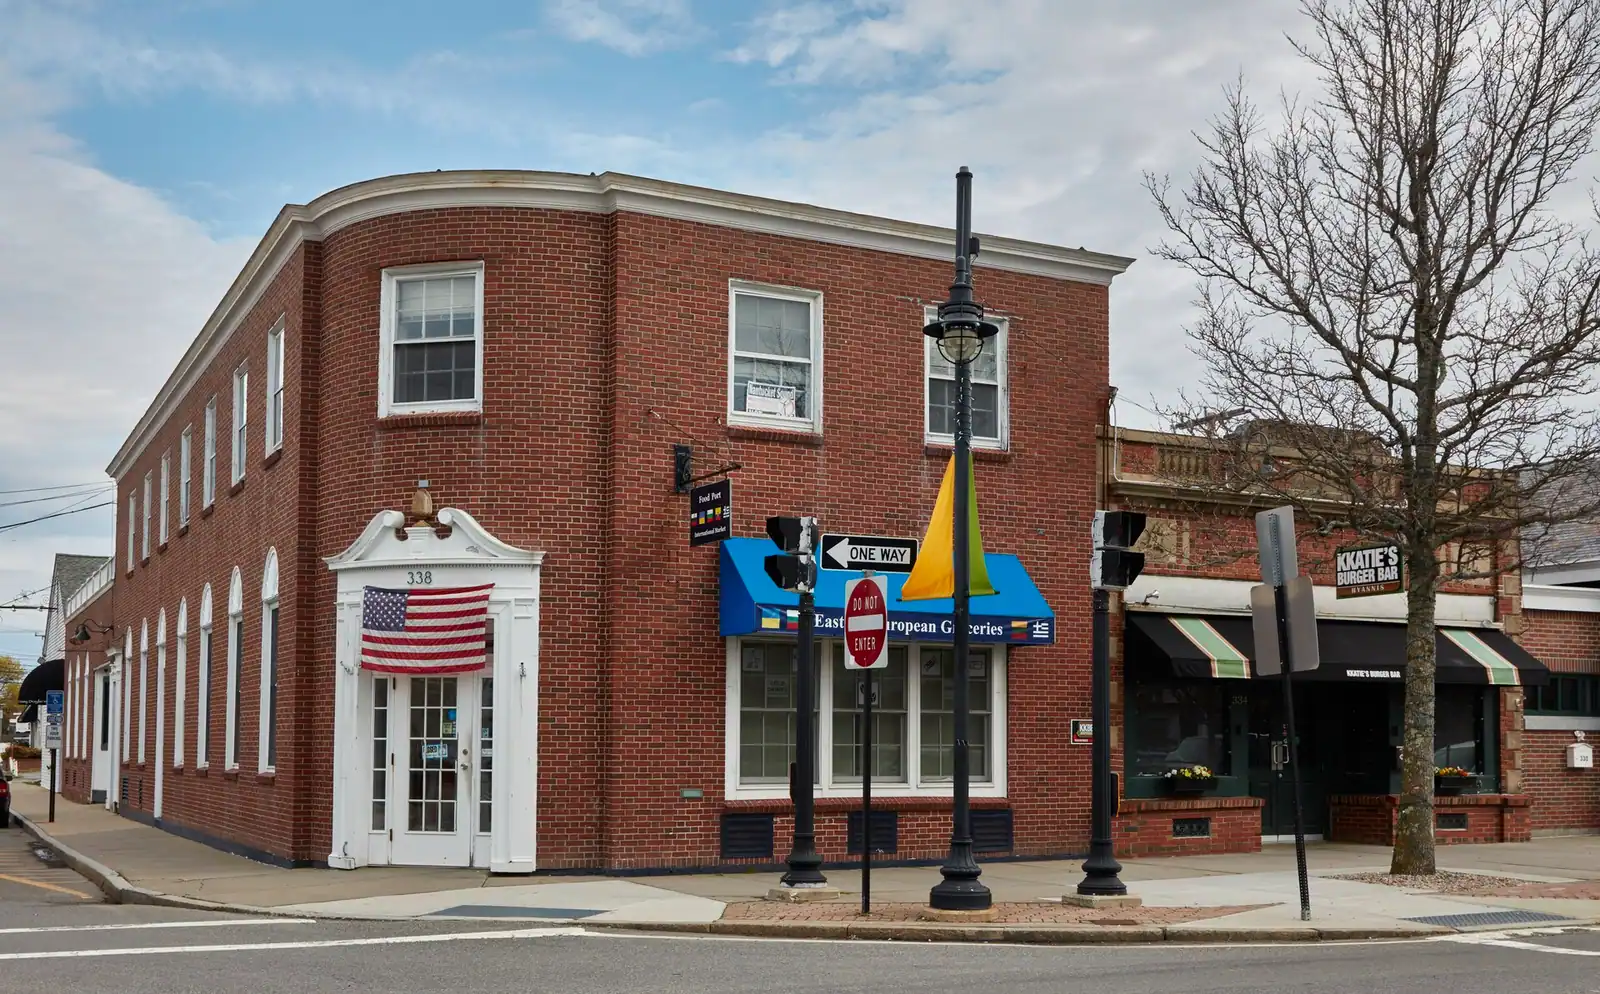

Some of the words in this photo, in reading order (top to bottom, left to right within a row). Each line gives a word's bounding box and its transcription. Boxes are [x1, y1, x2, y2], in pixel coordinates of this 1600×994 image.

[699, 493, 710, 503] Food
[711, 492, 721, 500] Port
[694, 528, 715, 538] International
[714, 526, 726, 534] Market
[850, 547, 876, 561] ONE
[880, 549, 907, 562] WAY
[1337, 546, 1398, 571] KKATIE'S
[407, 571, 432, 584] 338
[1337, 568, 1375, 586] BURGER
[1377, 566, 1398, 582] BAR
[1351, 584, 1384, 594] HYANNIS
[853, 598, 862, 611] DO
[865, 596, 878, 610] NOT
[814, 613, 845, 629] East
[885, 620, 936, 636] ropean
[941, 619, 1003, 636] Gceries
[855, 637, 876, 651] ENTER
[1346, 669, 1370, 678] KKATIE'S
[1370, 670, 1389, 678] BURGER
[1389, 670, 1401, 678] BAR
[1231, 695, 1248, 705] 334
